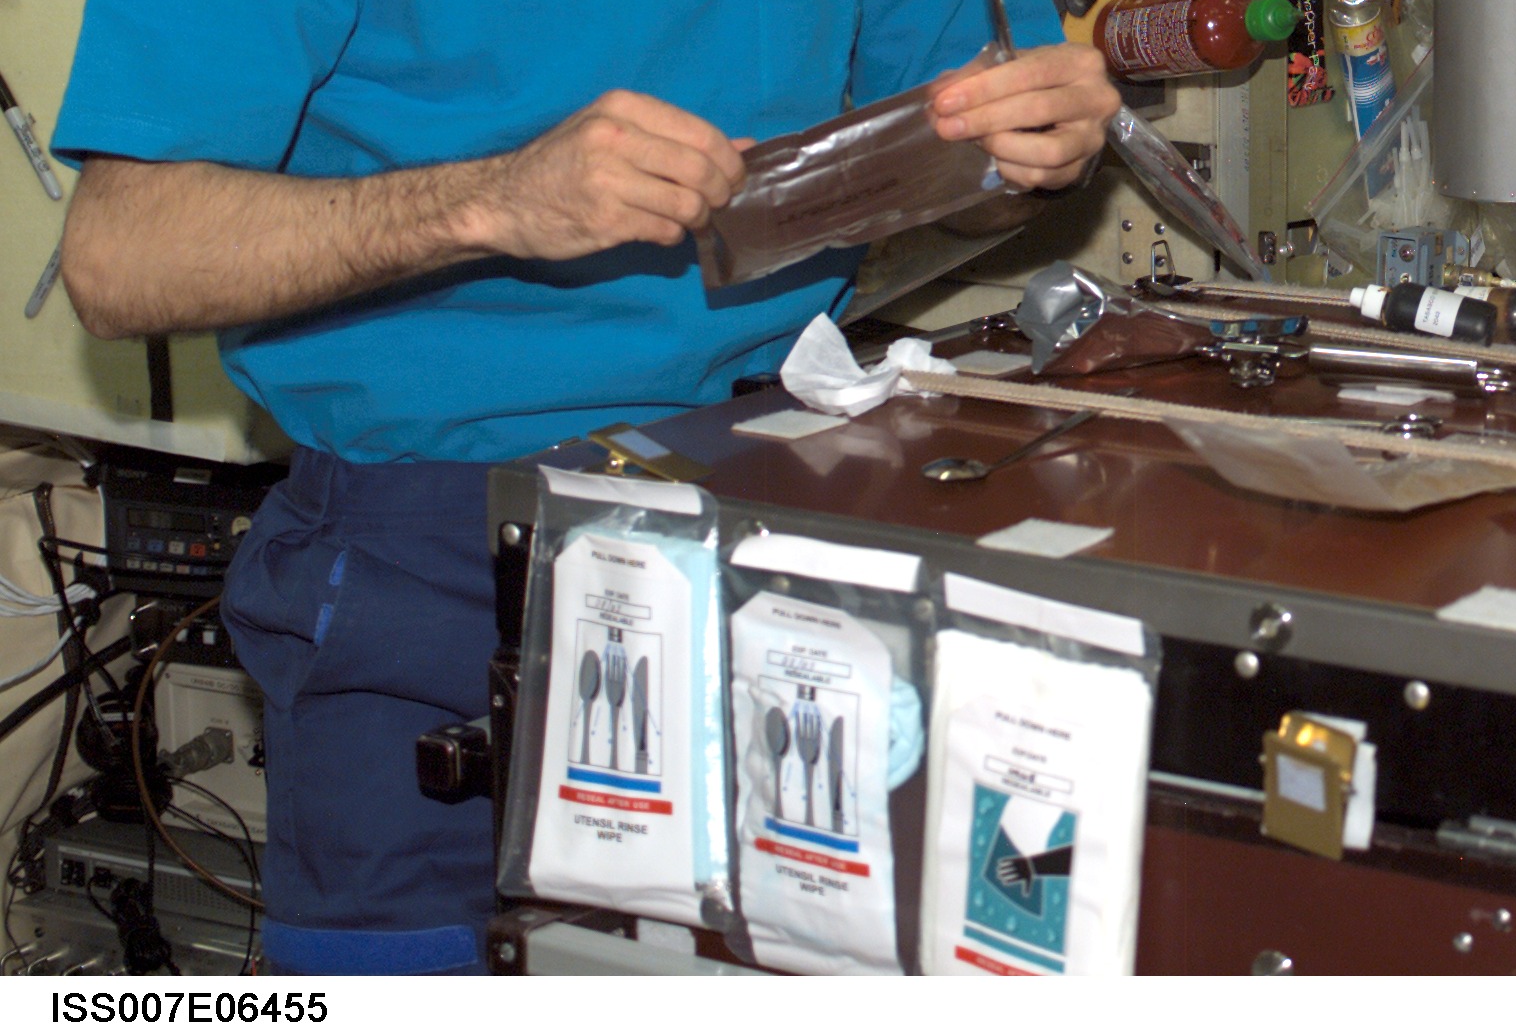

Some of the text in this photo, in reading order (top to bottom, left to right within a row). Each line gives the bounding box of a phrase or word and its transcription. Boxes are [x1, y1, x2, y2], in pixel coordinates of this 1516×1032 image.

[574, 814, 649, 835] UTENSIL RINSE
[597, 830, 623, 843] WIPE
[775, 863, 849, 891] UTENSIL RINSE
[799, 881, 825, 896] WIPE
